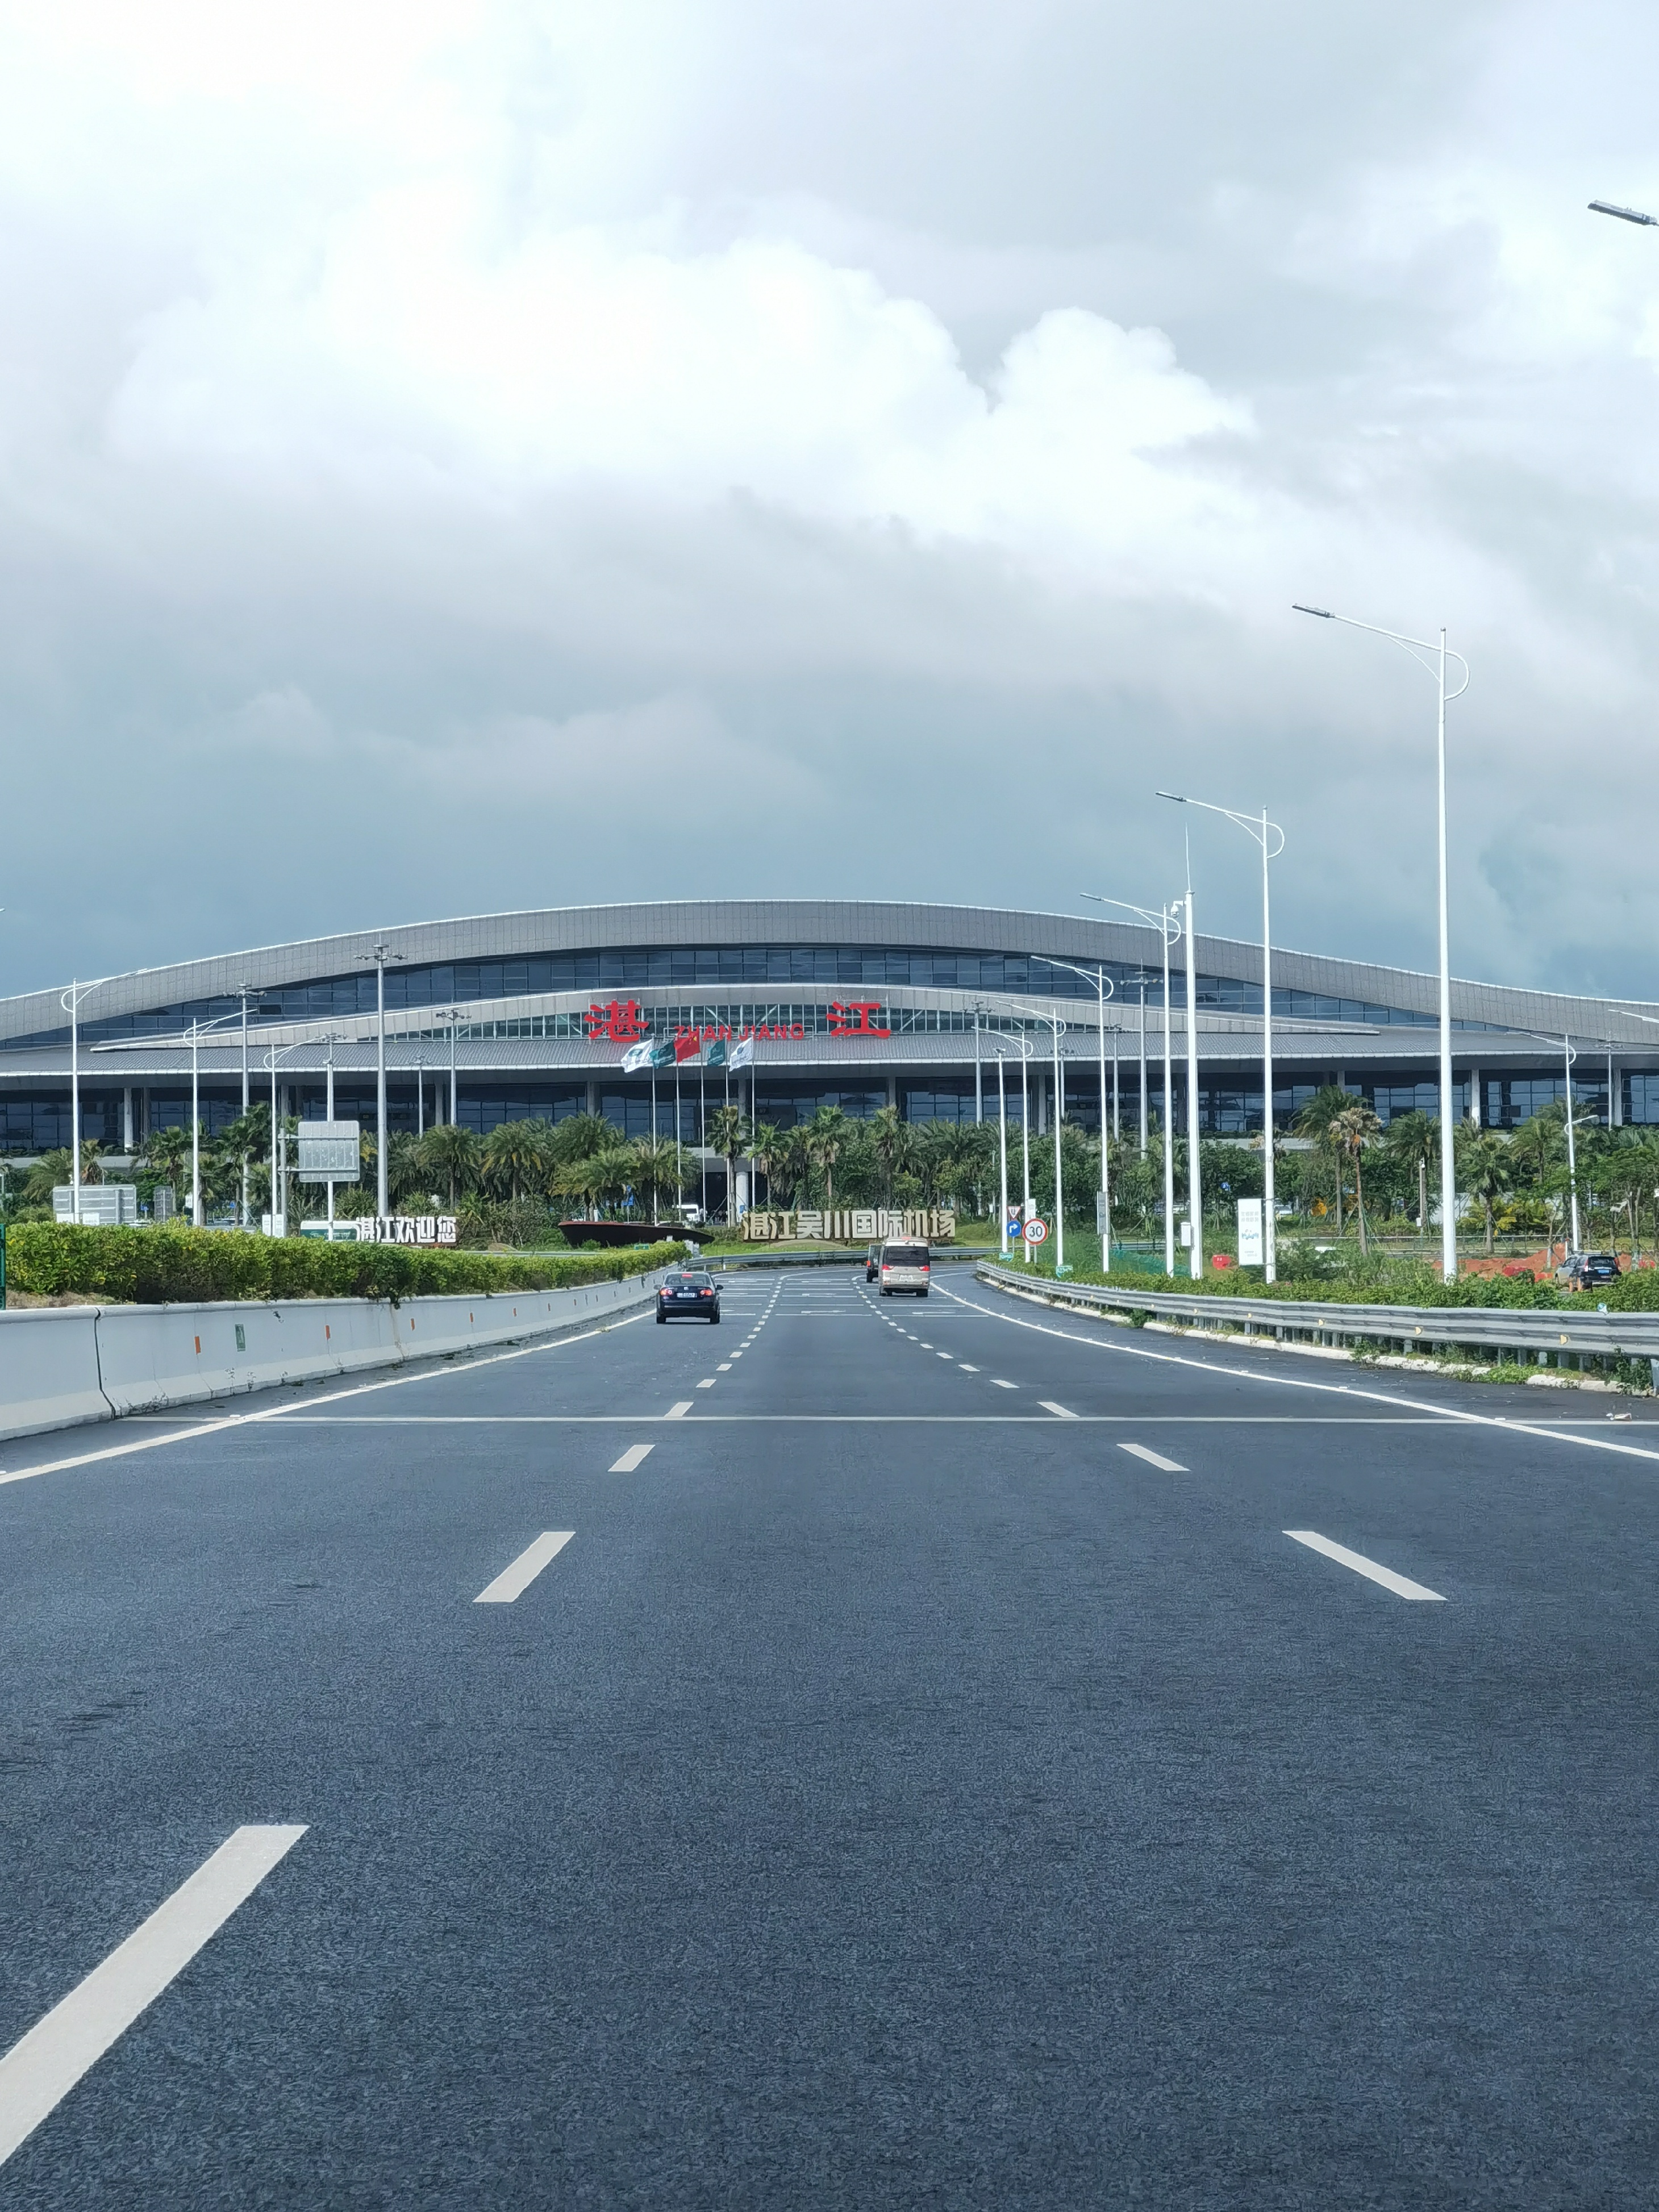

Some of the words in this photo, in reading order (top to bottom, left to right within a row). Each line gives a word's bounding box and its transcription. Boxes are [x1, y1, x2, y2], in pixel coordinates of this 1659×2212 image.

[585, 1000, 649, 1042] 湛
[827, 1001, 891, 1039] 江
[356, 1217, 456, 1243] 湛江欢迎您
[743, 1210, 956, 1239] 湛江吴川国际机场
[1029, 1226, 1043, 1237] 30
